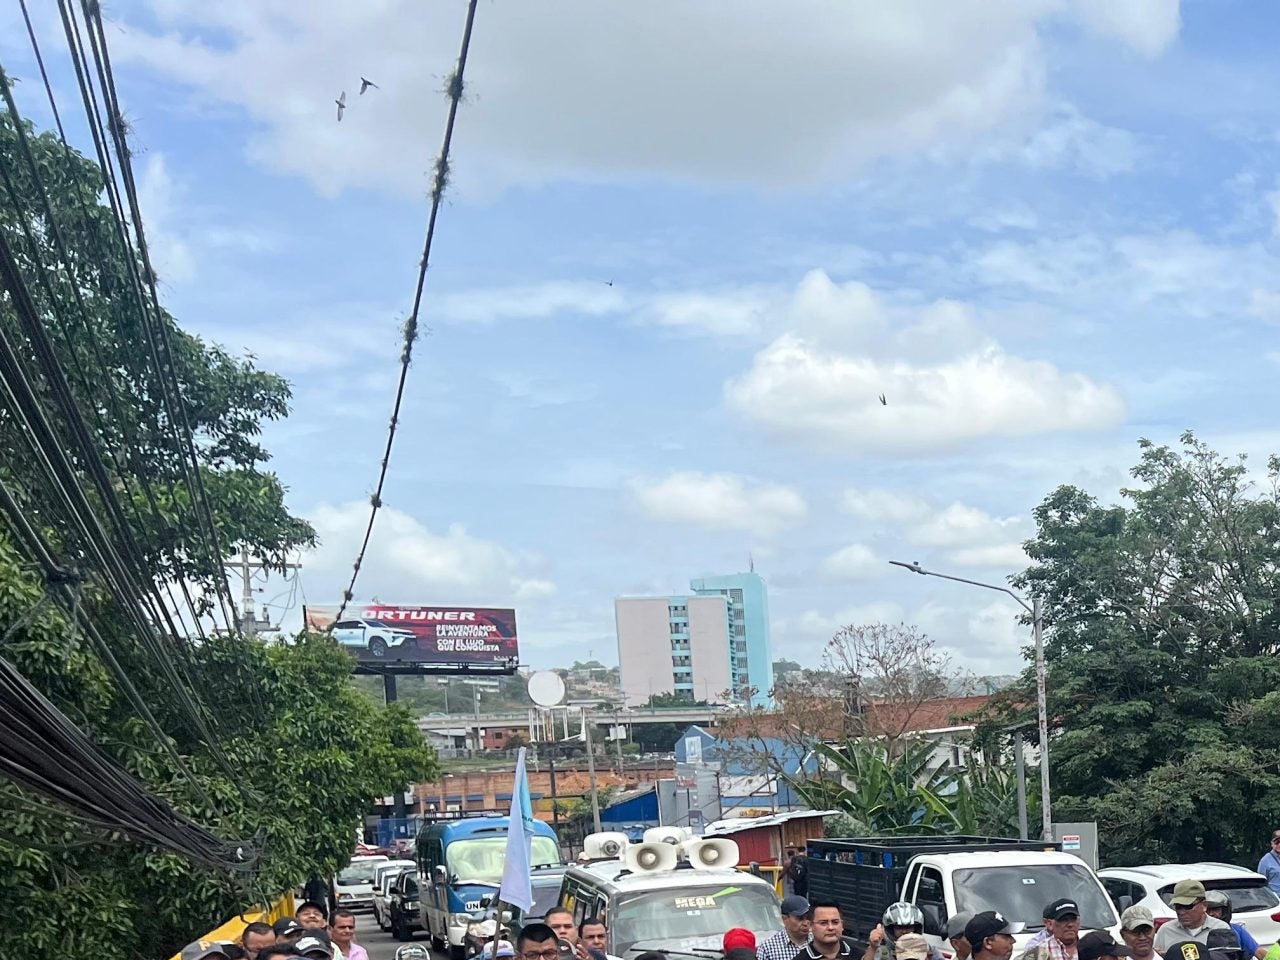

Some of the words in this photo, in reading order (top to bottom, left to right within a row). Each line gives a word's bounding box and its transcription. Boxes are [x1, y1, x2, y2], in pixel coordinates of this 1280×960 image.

[360, 609, 476, 622] ORTUNER
[436, 624, 497, 632] REINVENTAMOS
[675, 896, 716, 908] MEGA
